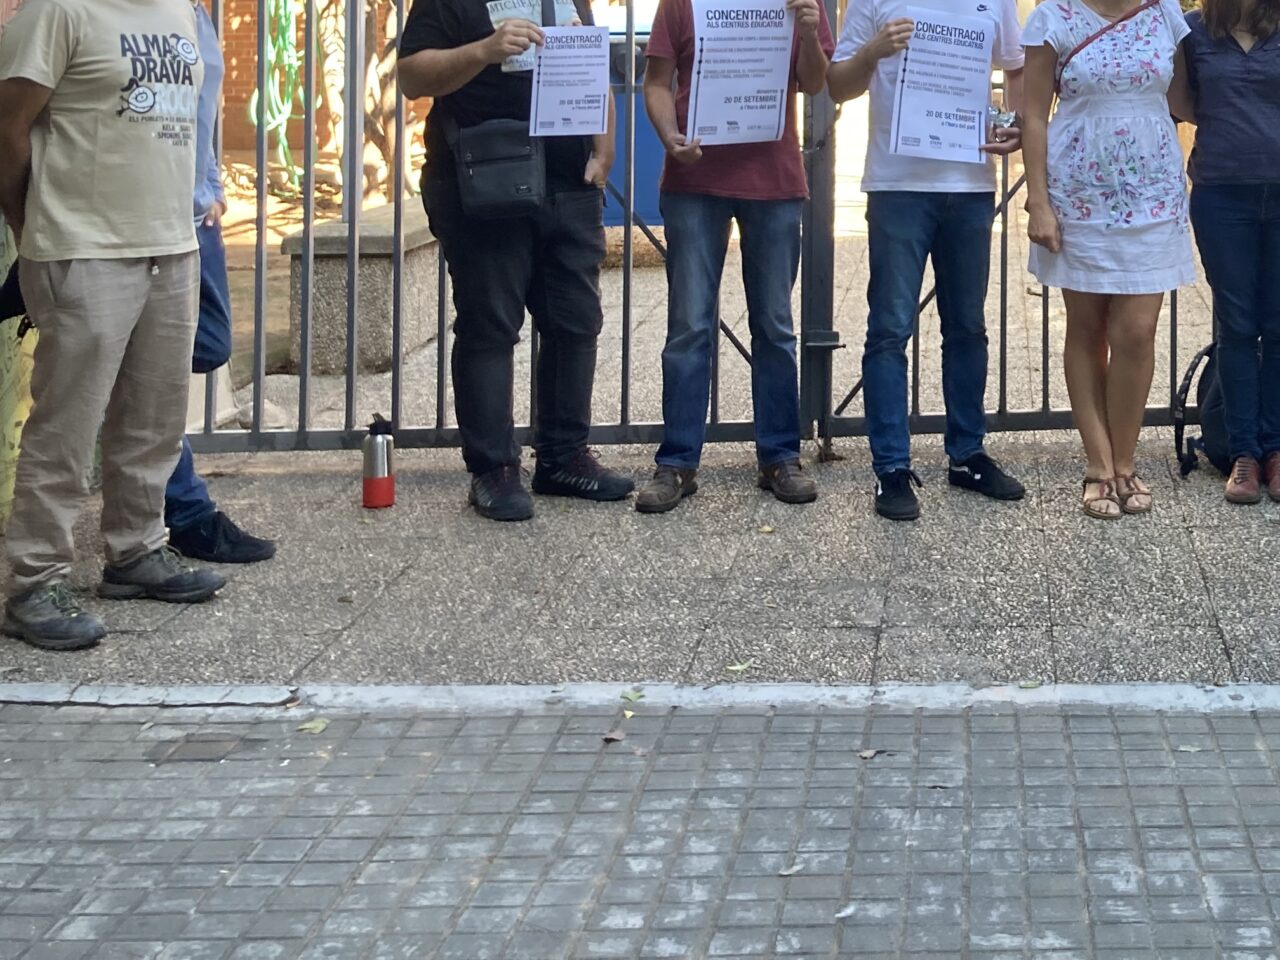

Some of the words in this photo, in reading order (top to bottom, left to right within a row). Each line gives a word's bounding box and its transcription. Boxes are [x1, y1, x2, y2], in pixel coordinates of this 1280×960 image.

[706, 8, 784, 20] CONCENTRACIÓ
[546, 34, 602, 44] CONCENTRACIÓ
[916, 21, 985, 42] CONCENTRACIÓ
[120, 34, 175, 58] ALMA
[914, 32, 925, 41] ALS
[927, 34, 952, 44] CENTRES
[954, 40, 983, 49] EDUCATIUS
[130, 57, 194, 86] DRAVA
[944, 112, 976, 122] SETEMBRE
